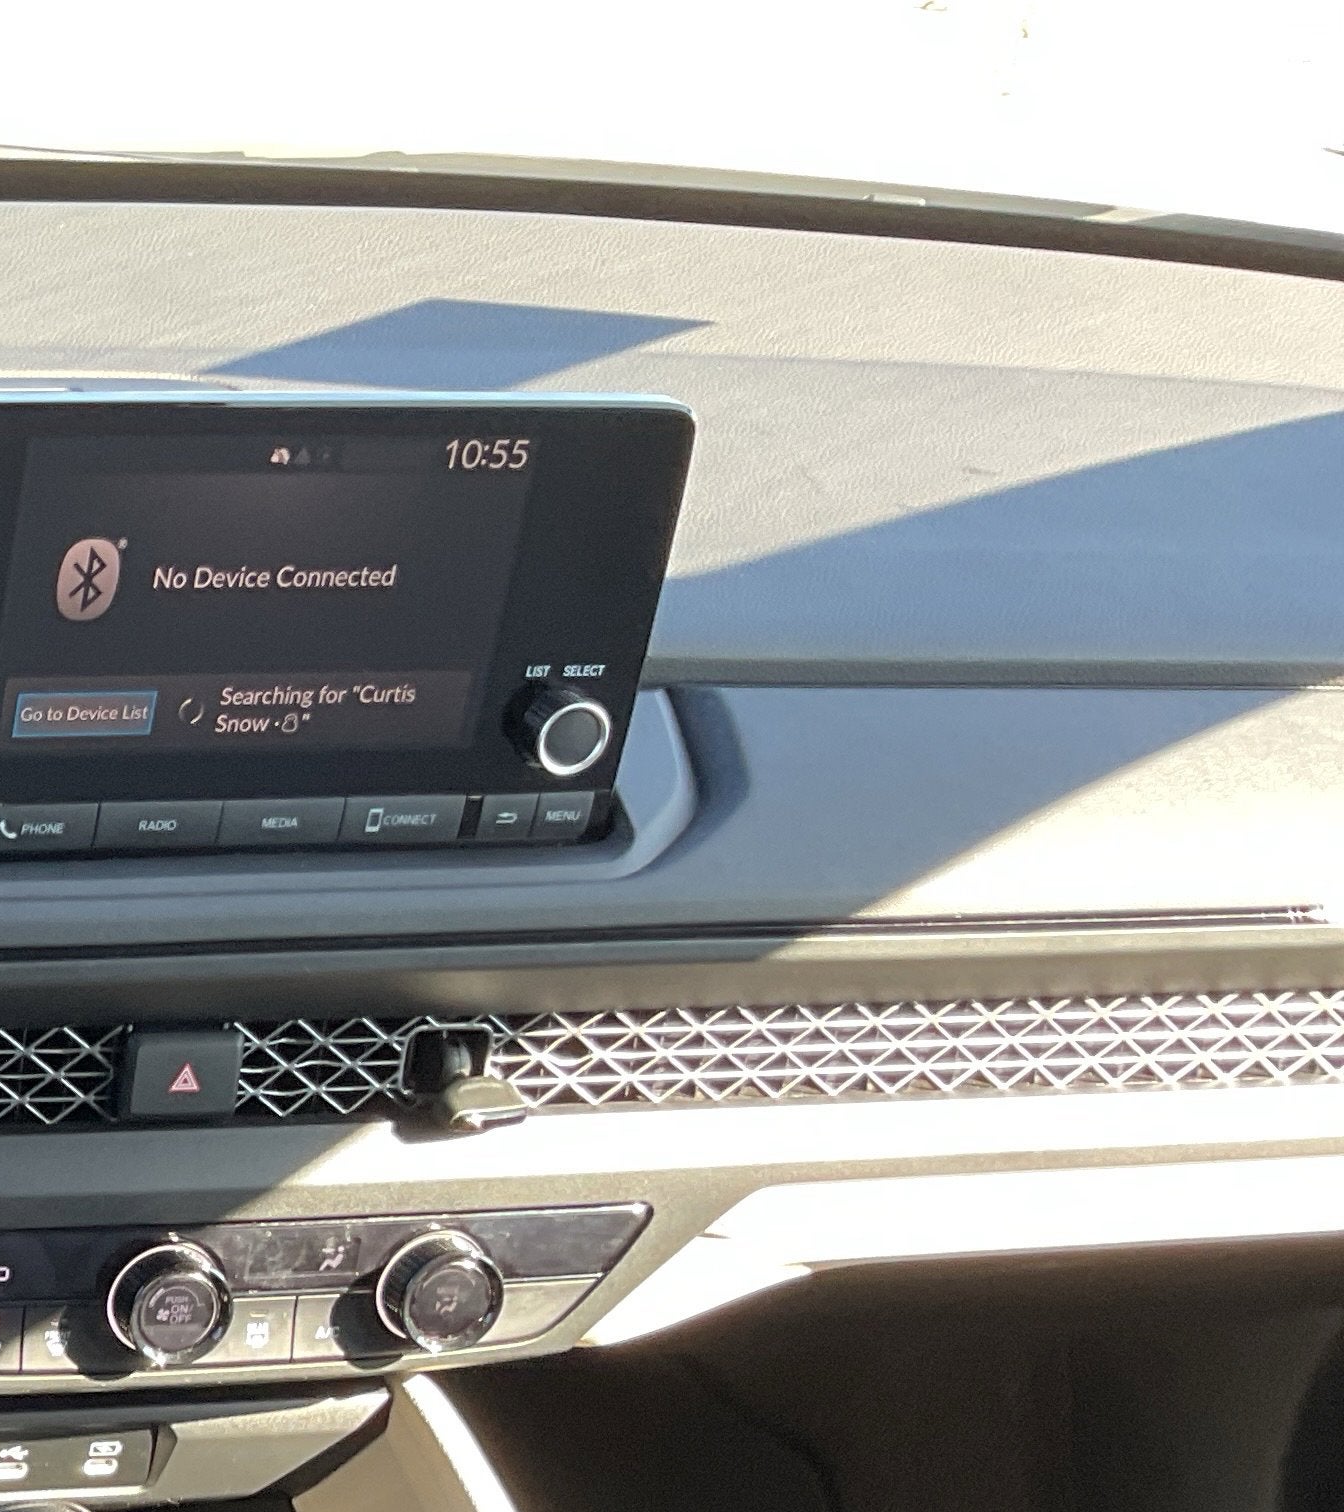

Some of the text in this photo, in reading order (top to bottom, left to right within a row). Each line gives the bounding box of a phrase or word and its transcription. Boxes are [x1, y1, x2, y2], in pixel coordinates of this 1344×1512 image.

[445, 438, 530, 470] 10:55
[152, 564, 398, 590] No Device Connected
[525, 664, 606, 678] LIST SELECT
[220, 684, 314, 708] Searching
[318, 683, 348, 704] for
[20, 704, 149, 723] Go to Device List
[215, 714, 270, 733] Snow
[261, 816, 298, 829] MEDIA
[382, 813, 437, 827] CONNECT
[545, 810, 581, 822] MENU
[20, 821, 65, 837] PHONE
[138, 819, 177, 832] RADIO
[165, 1295, 189, 1305] PUSH
[169, 1313, 192, 1324] OFF
[314, 1325, 341, 1340] A/C
